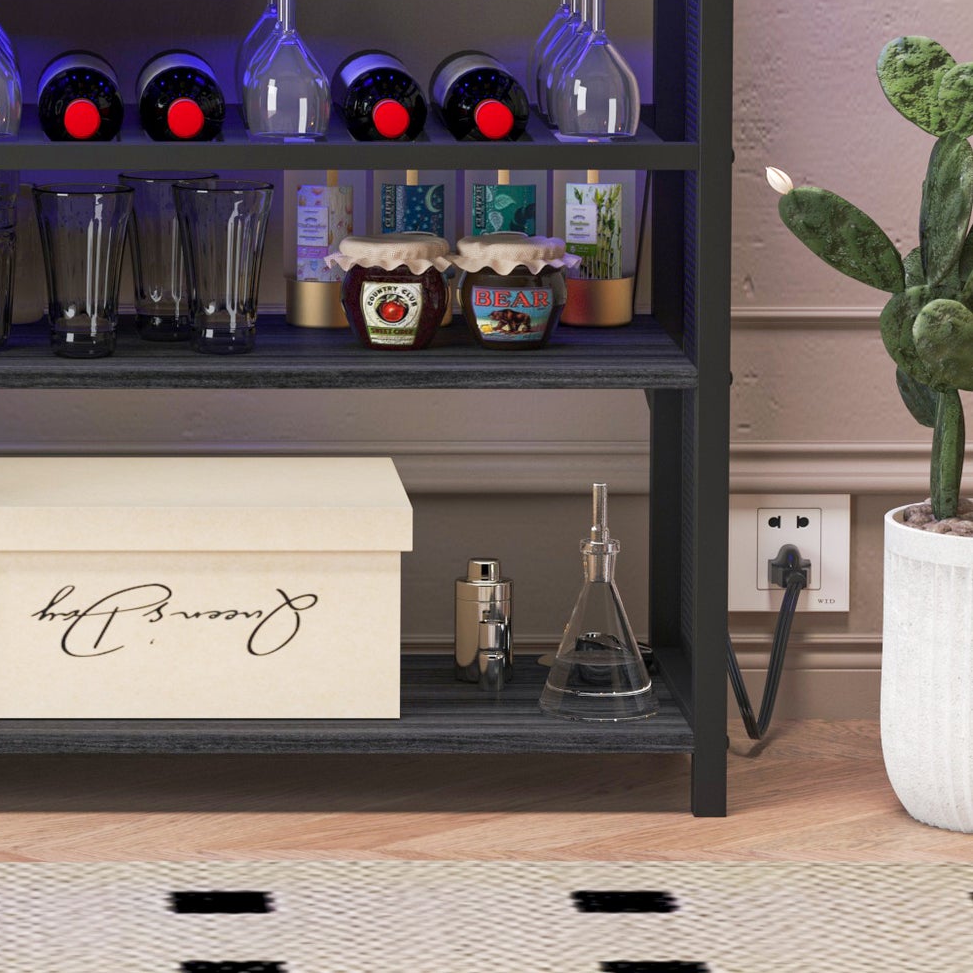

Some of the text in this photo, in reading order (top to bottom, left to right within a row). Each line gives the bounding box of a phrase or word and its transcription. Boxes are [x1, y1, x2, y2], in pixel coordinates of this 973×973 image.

[367, 286, 418, 307] COUNTRY CLUB
[475, 289, 551, 308] BEAR
